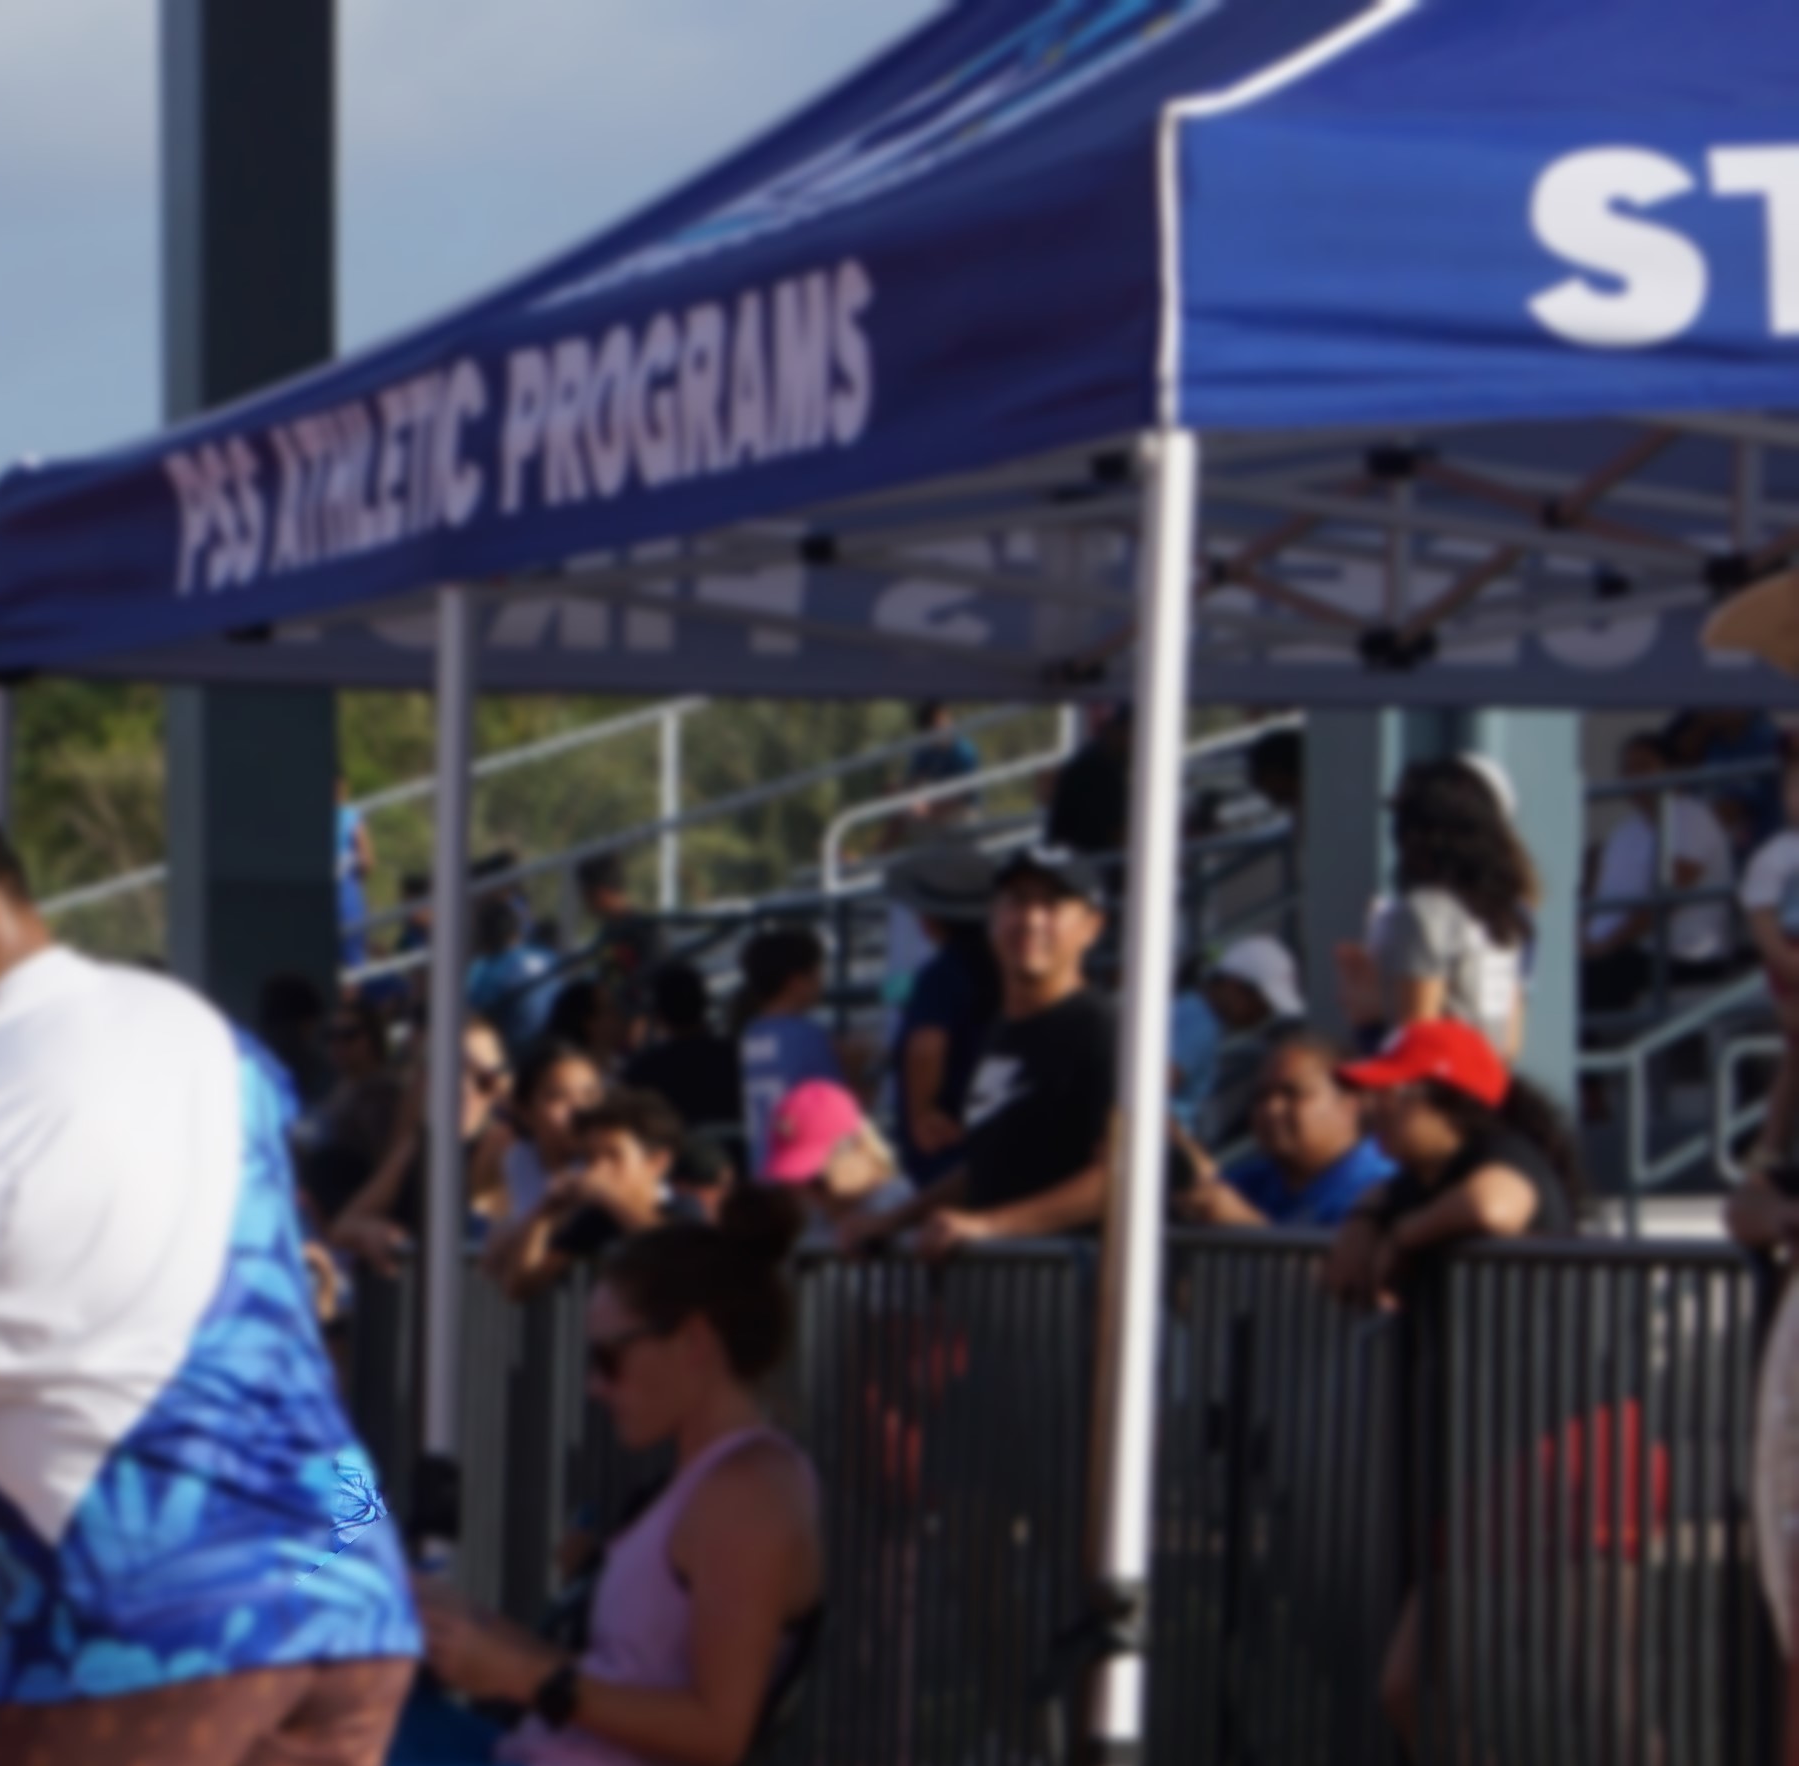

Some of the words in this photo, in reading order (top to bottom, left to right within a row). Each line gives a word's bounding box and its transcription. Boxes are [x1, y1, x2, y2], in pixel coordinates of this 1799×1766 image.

[164, 436, 264, 595] PSS
[269, 358, 487, 574] ATHLETIC
[499, 259, 874, 516] PROGRAMS
